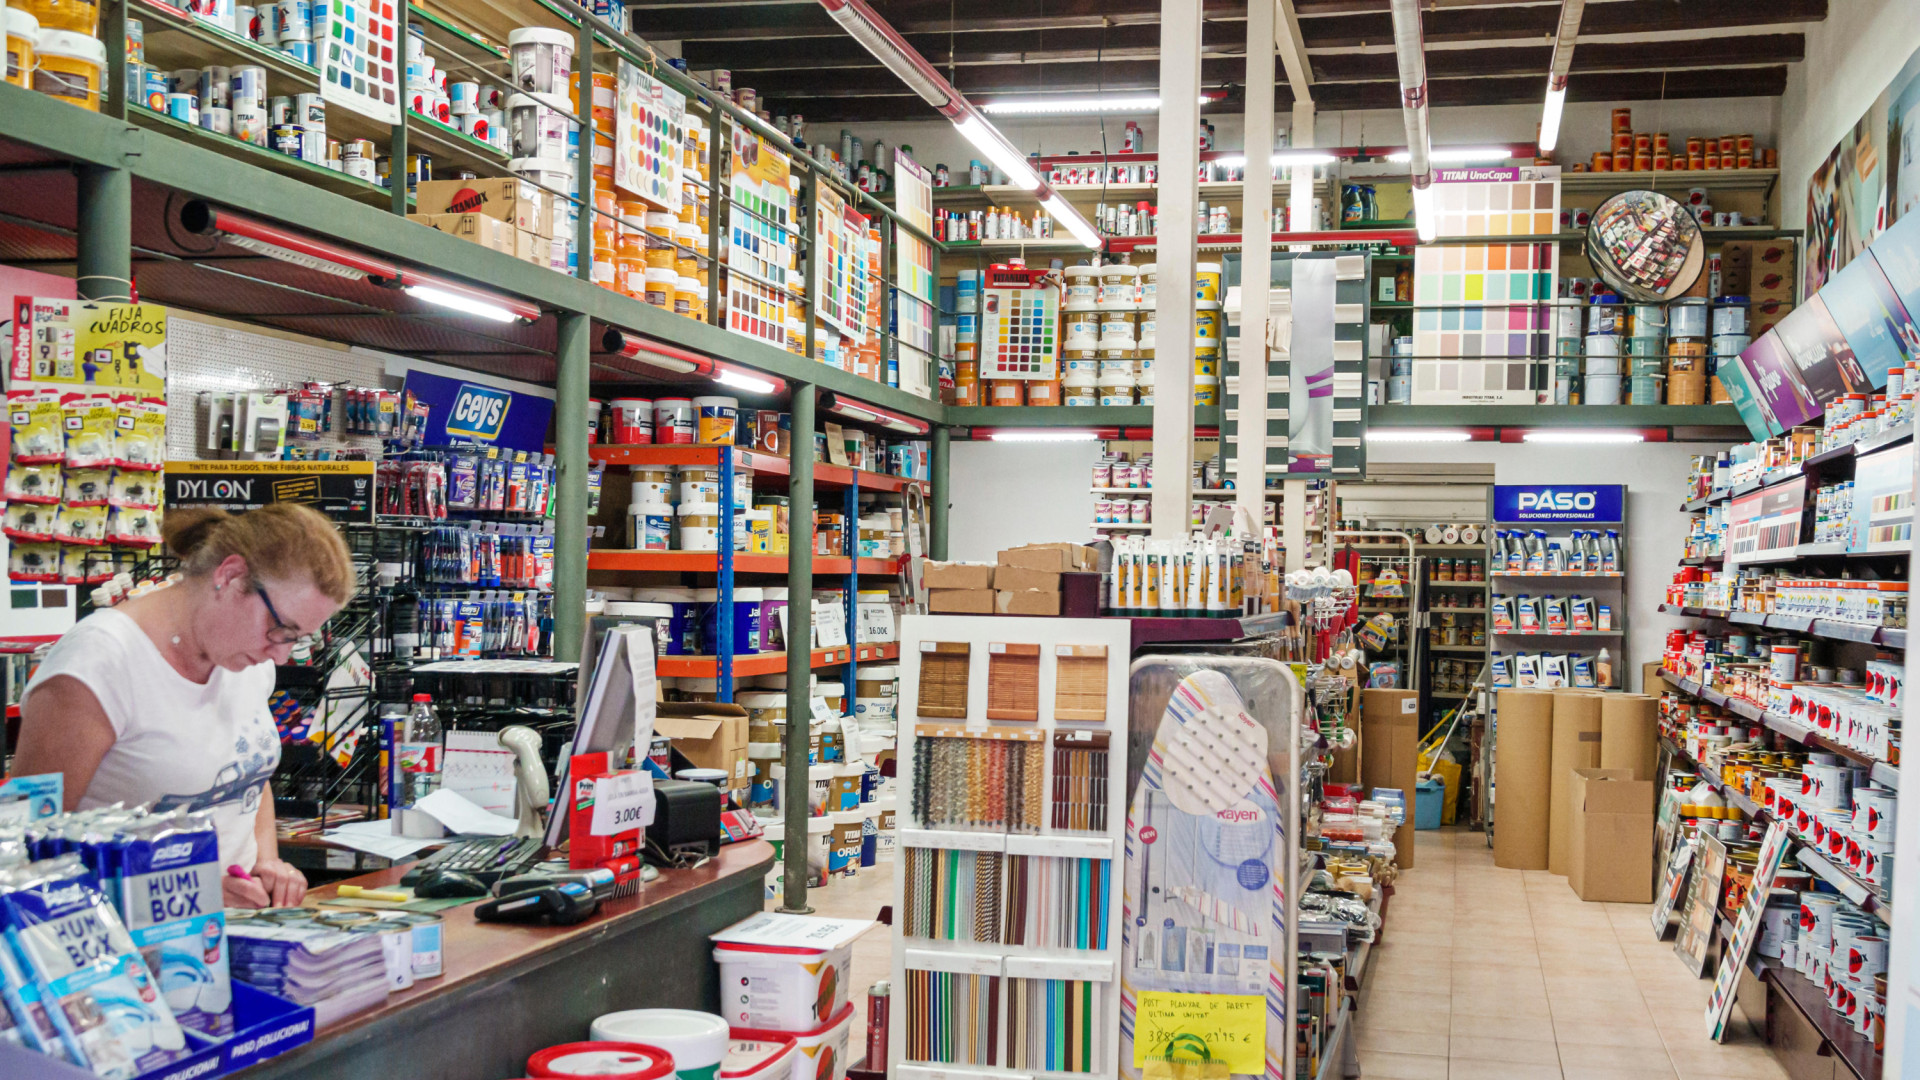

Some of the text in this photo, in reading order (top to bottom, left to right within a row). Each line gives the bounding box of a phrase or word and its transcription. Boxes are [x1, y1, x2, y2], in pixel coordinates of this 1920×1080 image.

[1442, 170, 1513, 182] TITAN UnaCapa
[993, 273, 1030, 282] TITANLUX
[34, 304, 70, 317] small
[109, 306, 144, 321] FIJA
[89, 321, 164, 335] CUADROS
[13, 326, 31, 379] fischer
[455, 392, 504, 431] ceys
[177, 479, 251, 500] DYLON
[1518, 489, 1596, 511] PASO
[869, 626, 888, 635] 16.00€
[1238, 711, 1256, 729] Rayen
[614, 806, 643, 825] 3.00€
[1217, 809, 1258, 823] Rayen
[1140, 830, 1156, 840] NEW
[147, 870, 200, 897] HUMI
[151, 892, 202, 923] BOX
[66, 933, 118, 968] BOX
[1143, 997, 1160, 1008] POST
[1209, 1001, 1220, 1010] DE
